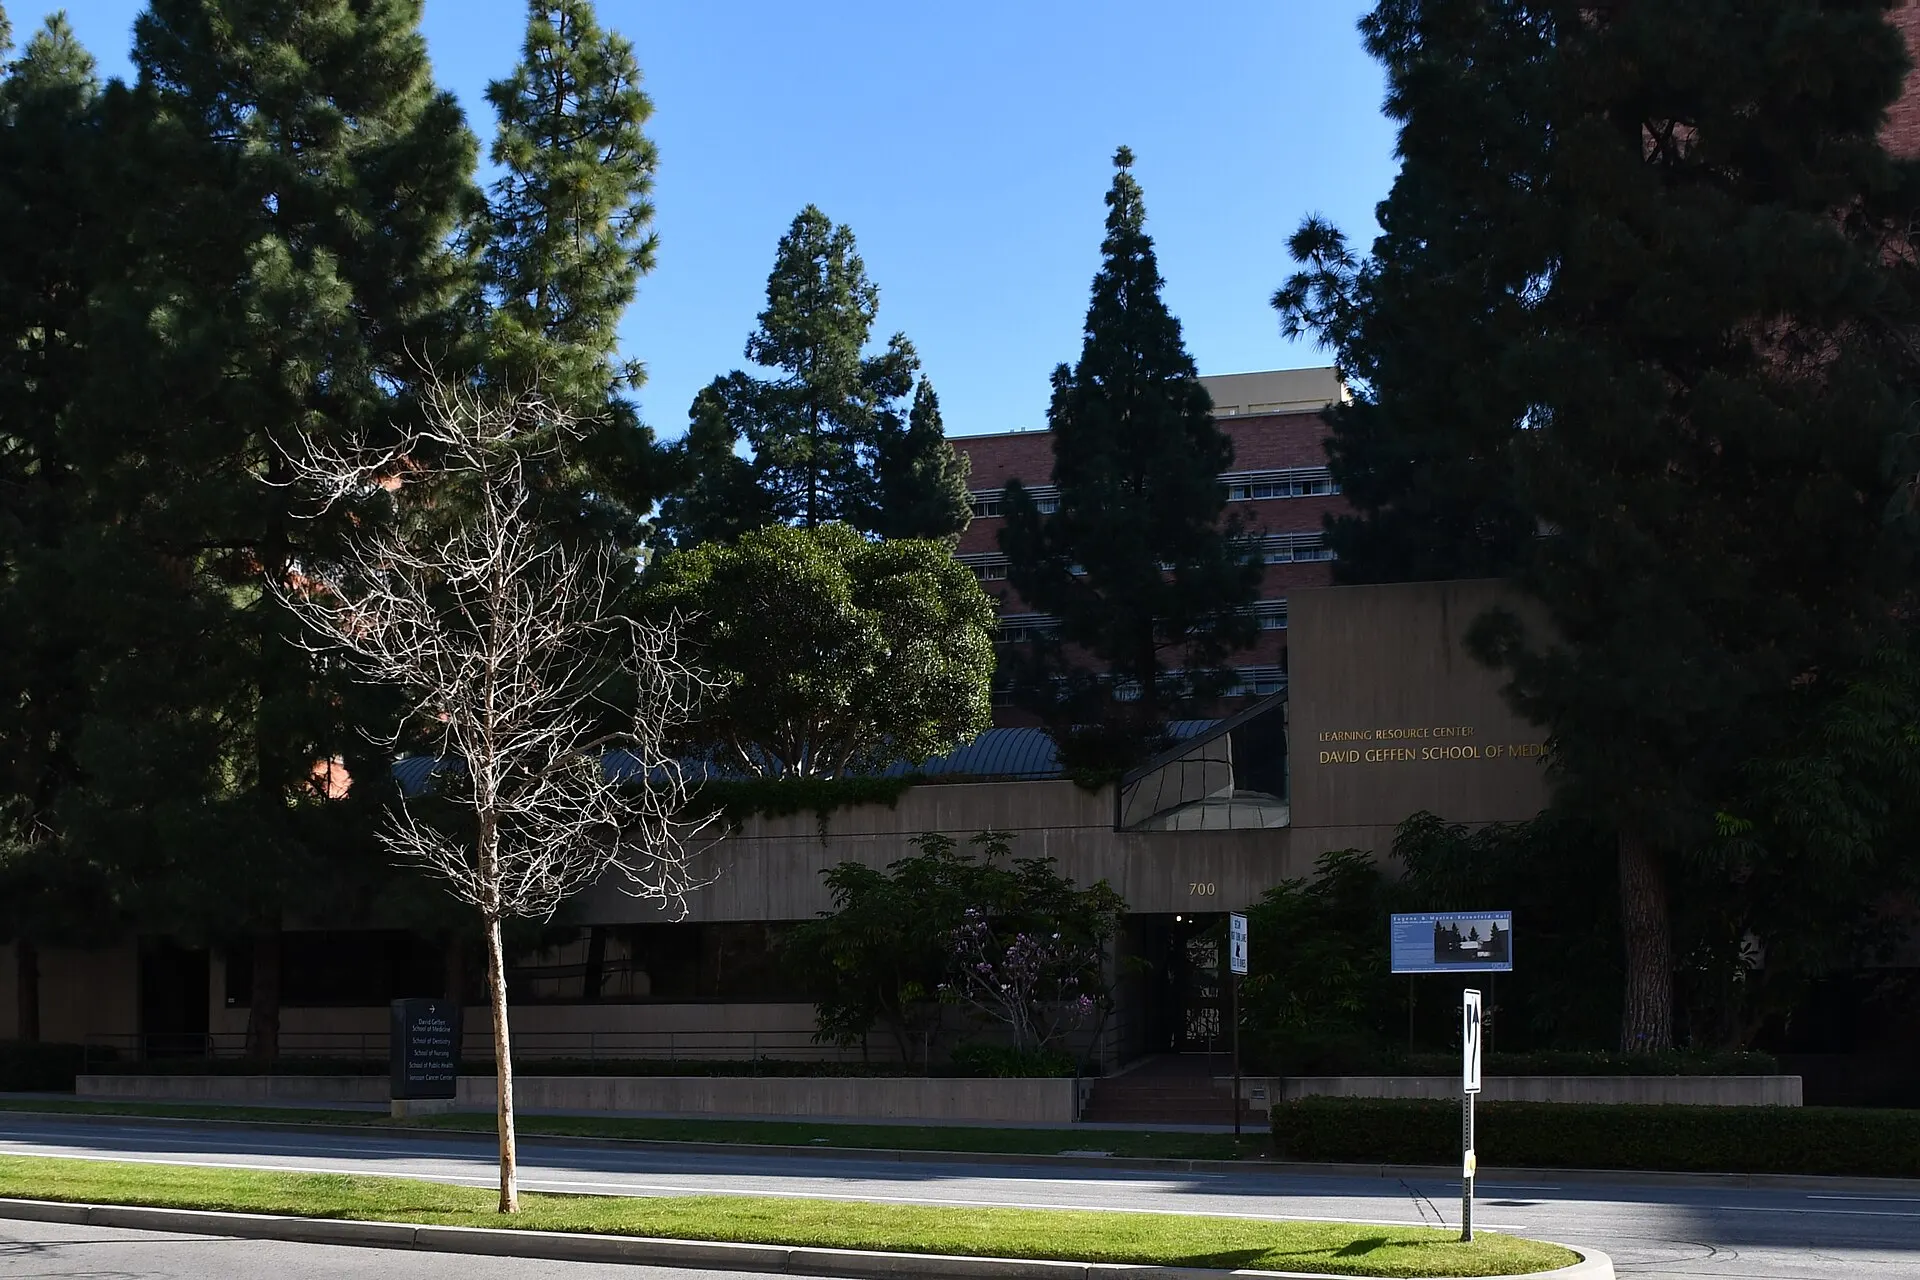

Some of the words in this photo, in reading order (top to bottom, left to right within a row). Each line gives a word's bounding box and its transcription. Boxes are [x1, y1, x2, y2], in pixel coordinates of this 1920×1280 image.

[1319, 730, 1372, 742] LEARNING
[1376, 728, 1429, 740] RESOURCE
[1433, 726, 1475, 738] CENTER
[1319, 750, 1360, 764] DAVID
[1365, 748, 1416, 763] GEFFEN
[1421, 746, 1480, 761] SCHOOL
[1485, 744, 1504, 758] OF
[1189, 882, 1215, 896] 700
[412, 1024, 426, 1032] School
[412, 1036, 426, 1044] School
